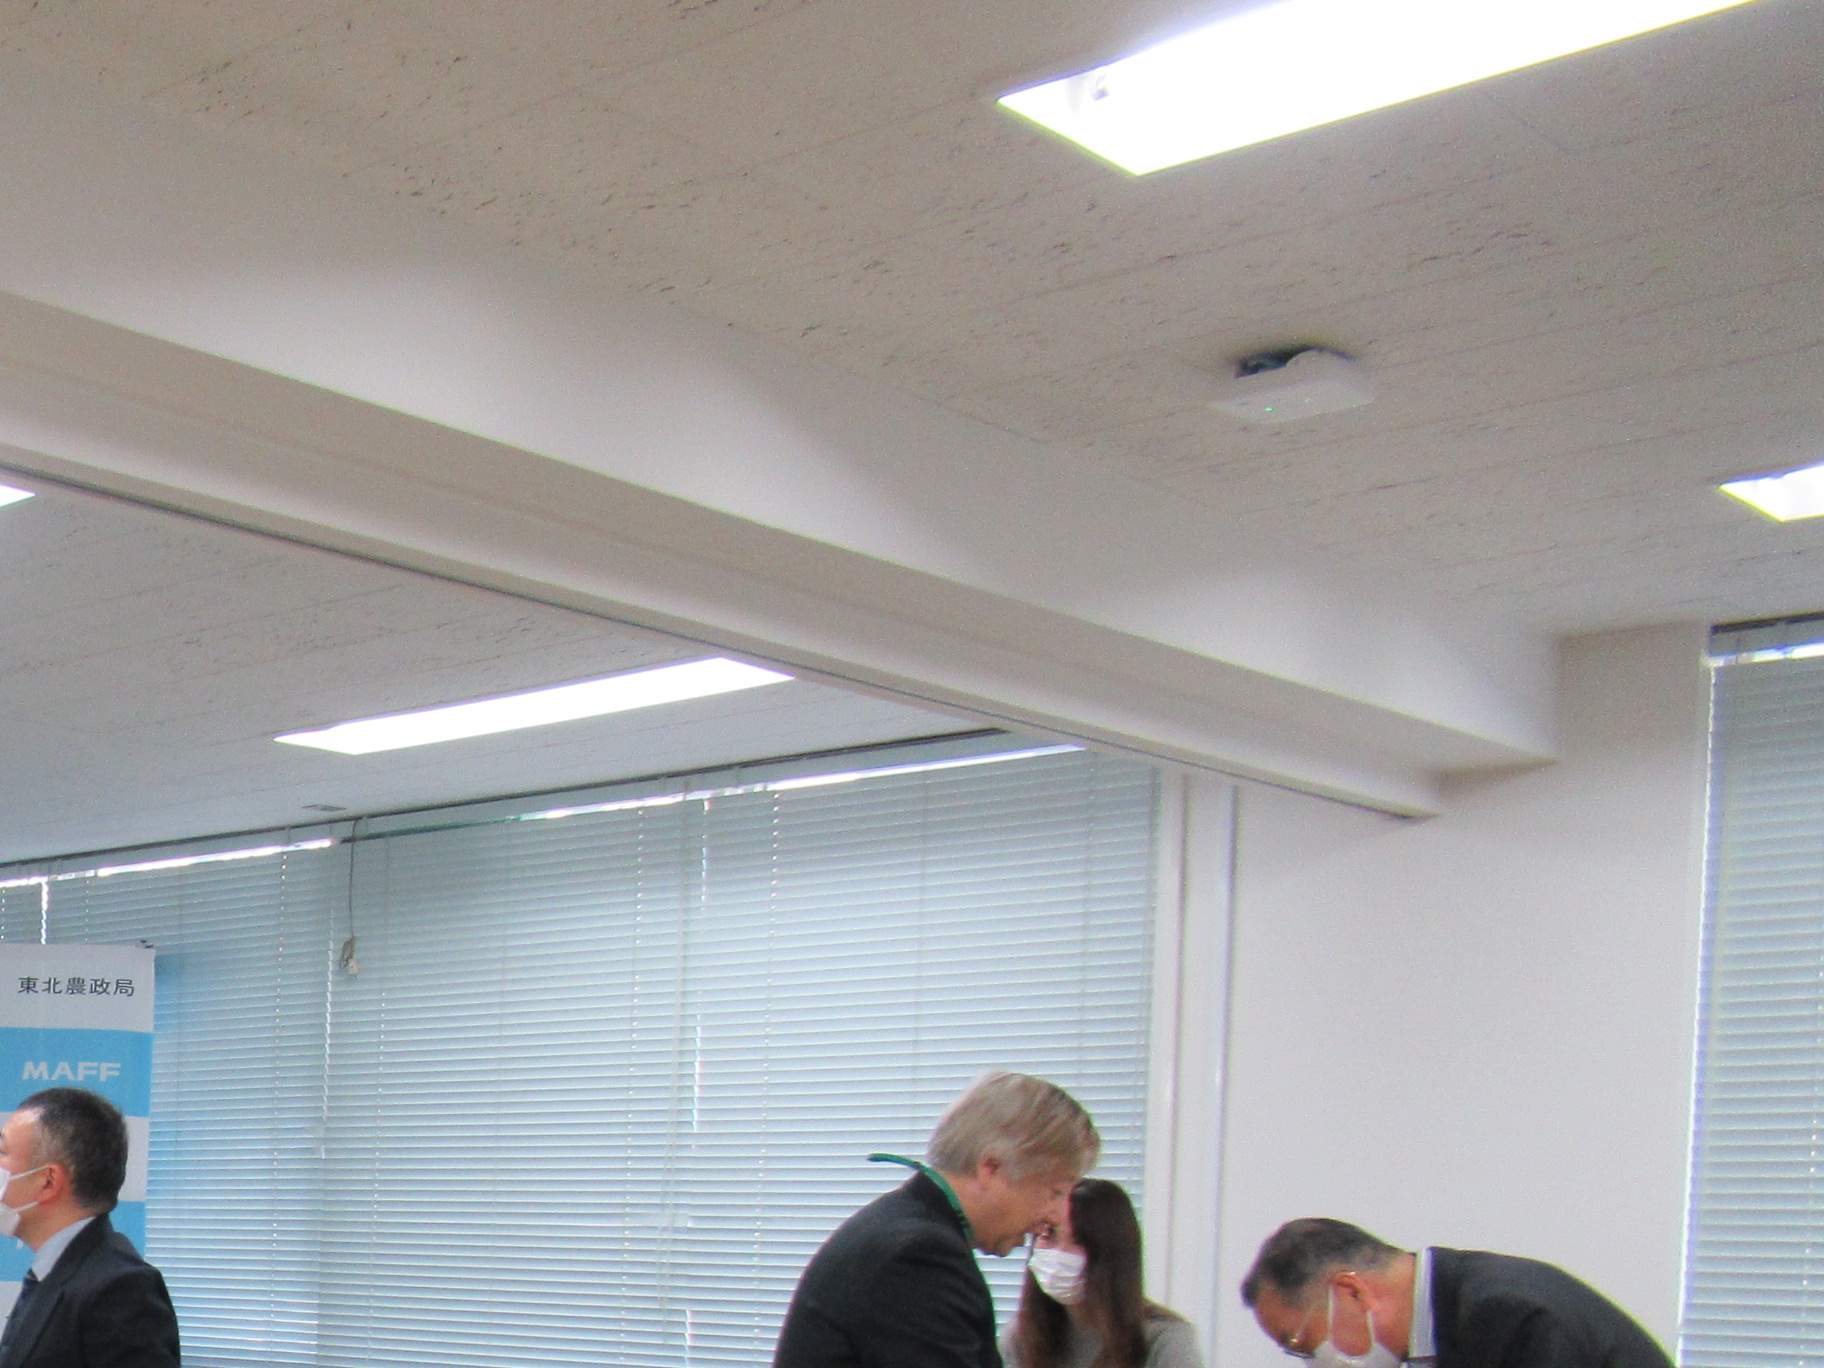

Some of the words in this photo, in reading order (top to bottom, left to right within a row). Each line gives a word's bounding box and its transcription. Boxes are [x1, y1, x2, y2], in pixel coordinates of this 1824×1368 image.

[18, 976, 135, 997] 東北農政局
[21, 1061, 122, 1082] MAFF
